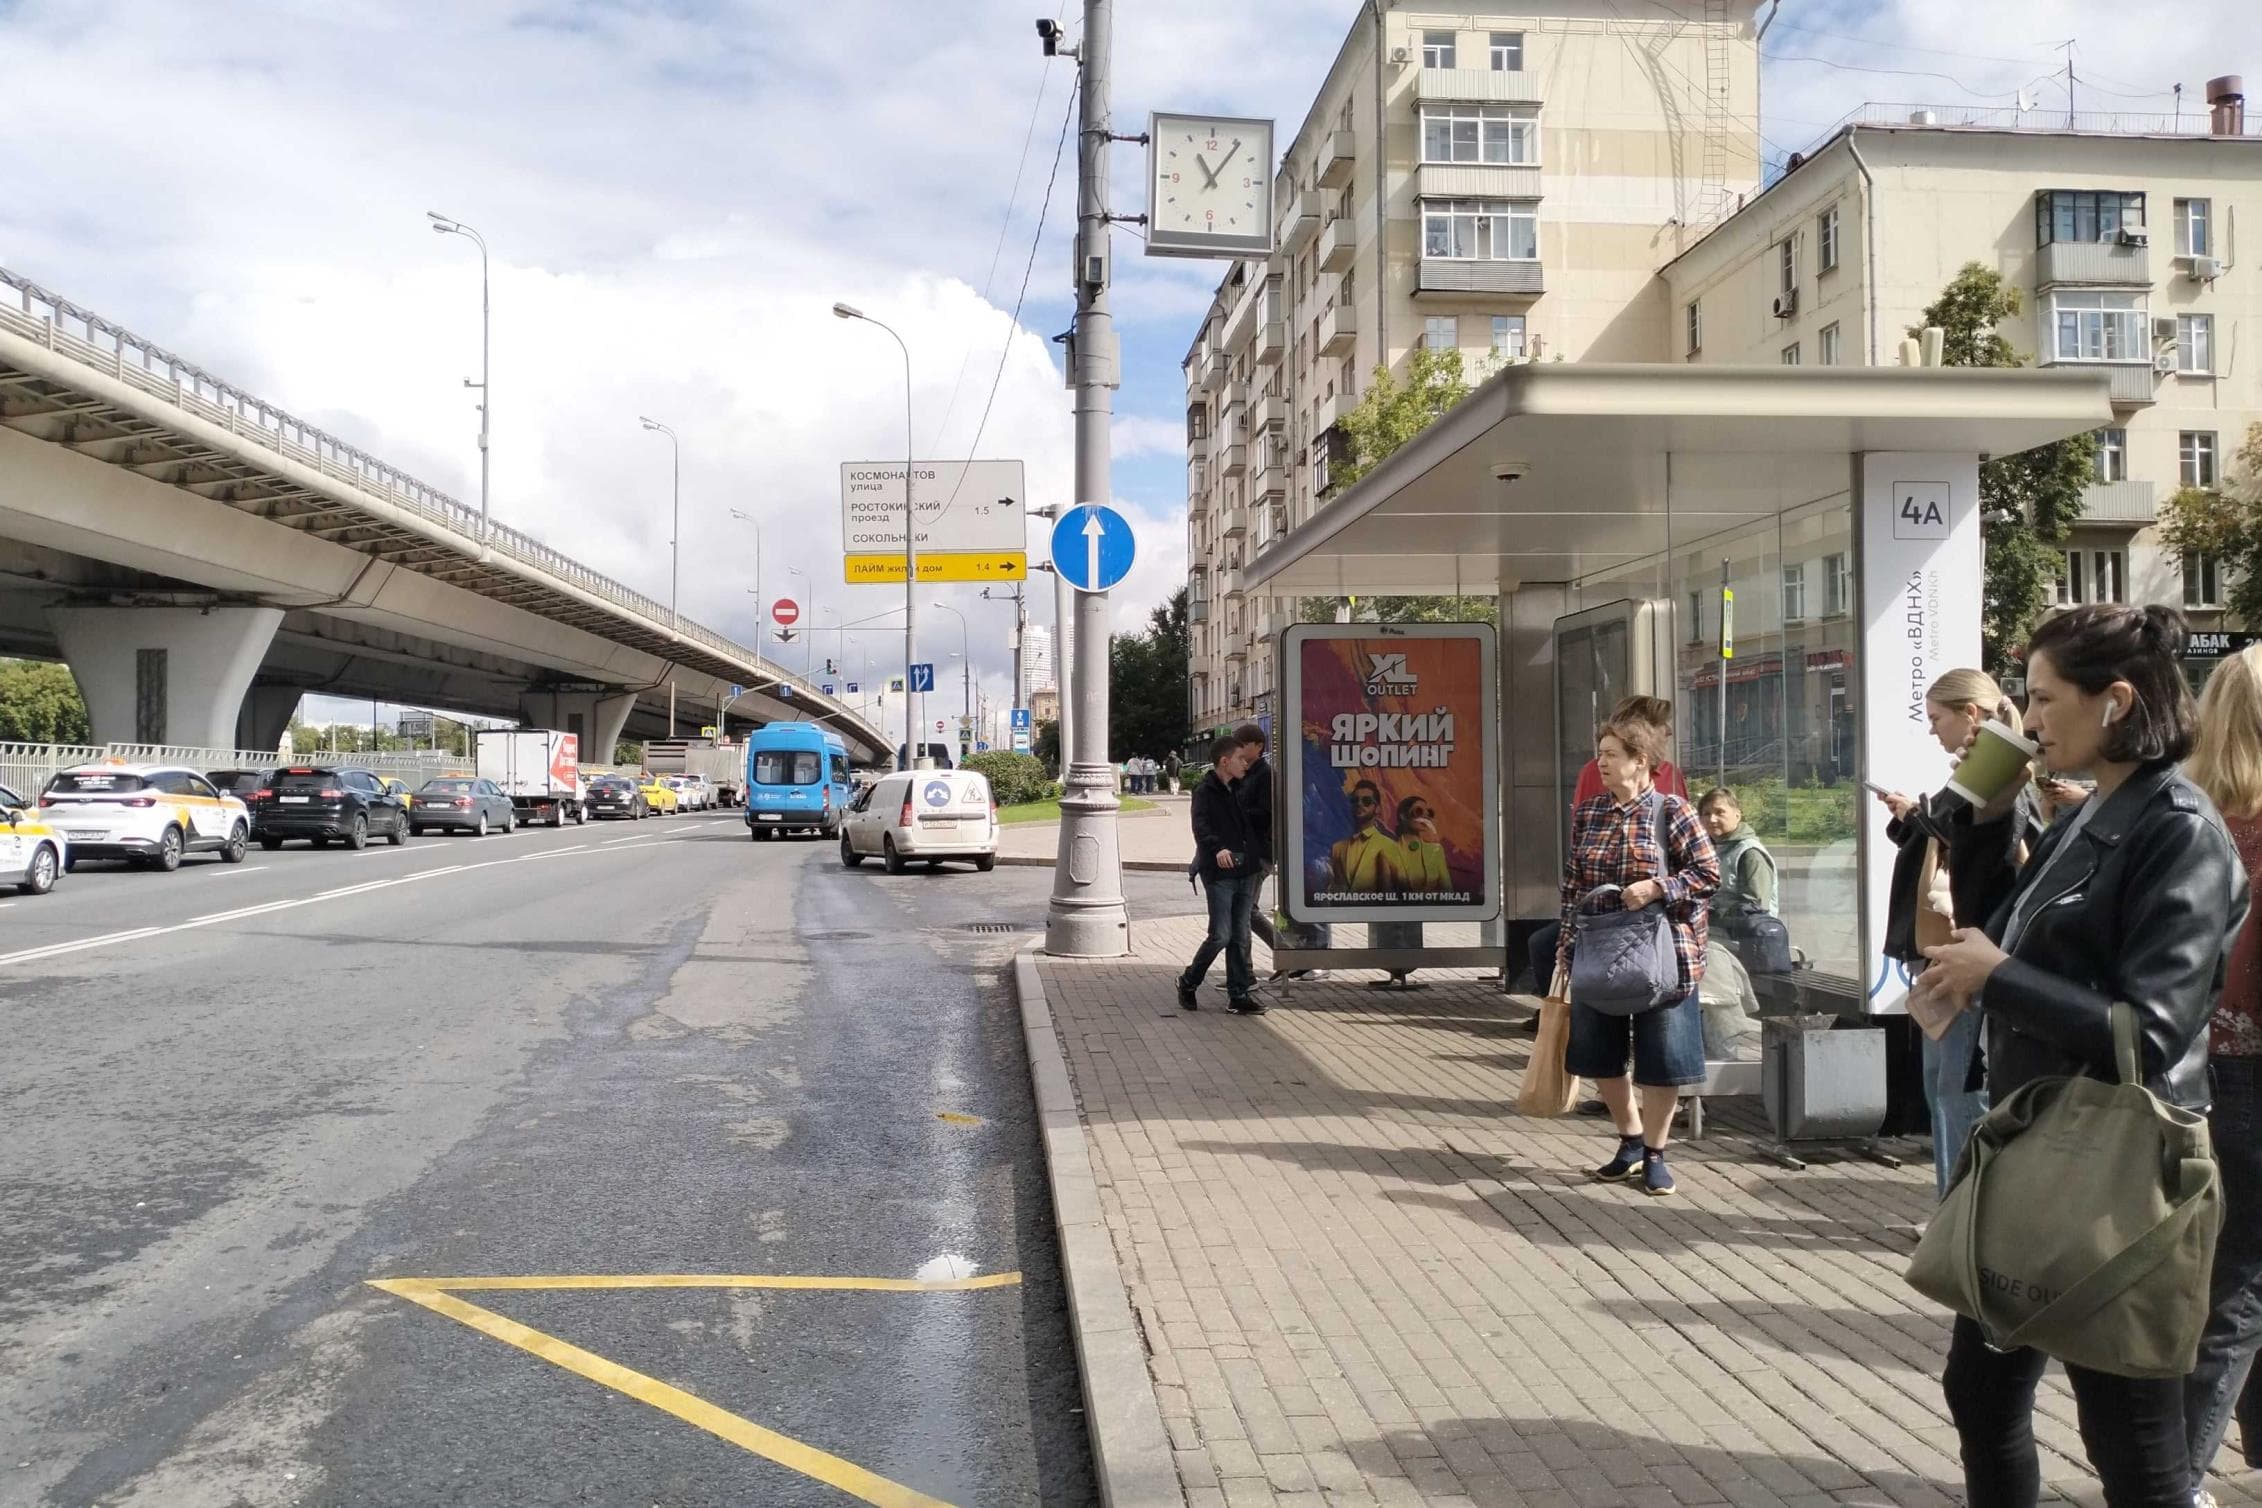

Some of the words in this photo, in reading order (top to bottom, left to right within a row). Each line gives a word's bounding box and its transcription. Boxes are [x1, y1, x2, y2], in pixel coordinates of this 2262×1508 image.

[1206, 140, 1218, 151] 12
[1172, 172, 1180, 183] 9
[1243, 177, 1251, 188] 3
[1205, 210, 1213, 220] 6
[850, 483, 883, 492] улица
[975, 506, 990, 515] 1.5
[1901, 496, 1943, 525] 4А
[851, 514, 890, 523] проезд
[852, 532, 929, 543] СОКОЛЬНКИ
[922, 565, 943, 573] дом
[976, 562, 990, 571] 1.4
[1907, 570, 1925, 650] «ВДНХ»
[1928, 620, 1939, 662] Metro
[2190, 634, 2231, 648] АБАК
[1367, 653, 1418, 683] XL
[1367, 684, 1417, 695] OUTLET
[1908, 656, 1926, 723] Метро
[1331, 706, 1456, 743] ЯРКИЙ
[1330, 744, 1456, 769] ШОПИНГ
[1402, 892, 1407, 902] 1
[1409, 892, 1423, 902] КМ
[1425, 892, 1437, 902] ОТ
[1439, 892, 1470, 902] МКАД
[1980, 1266, 2025, 1297] SIDE
[2028, 1286, 2063, 1304] OU
